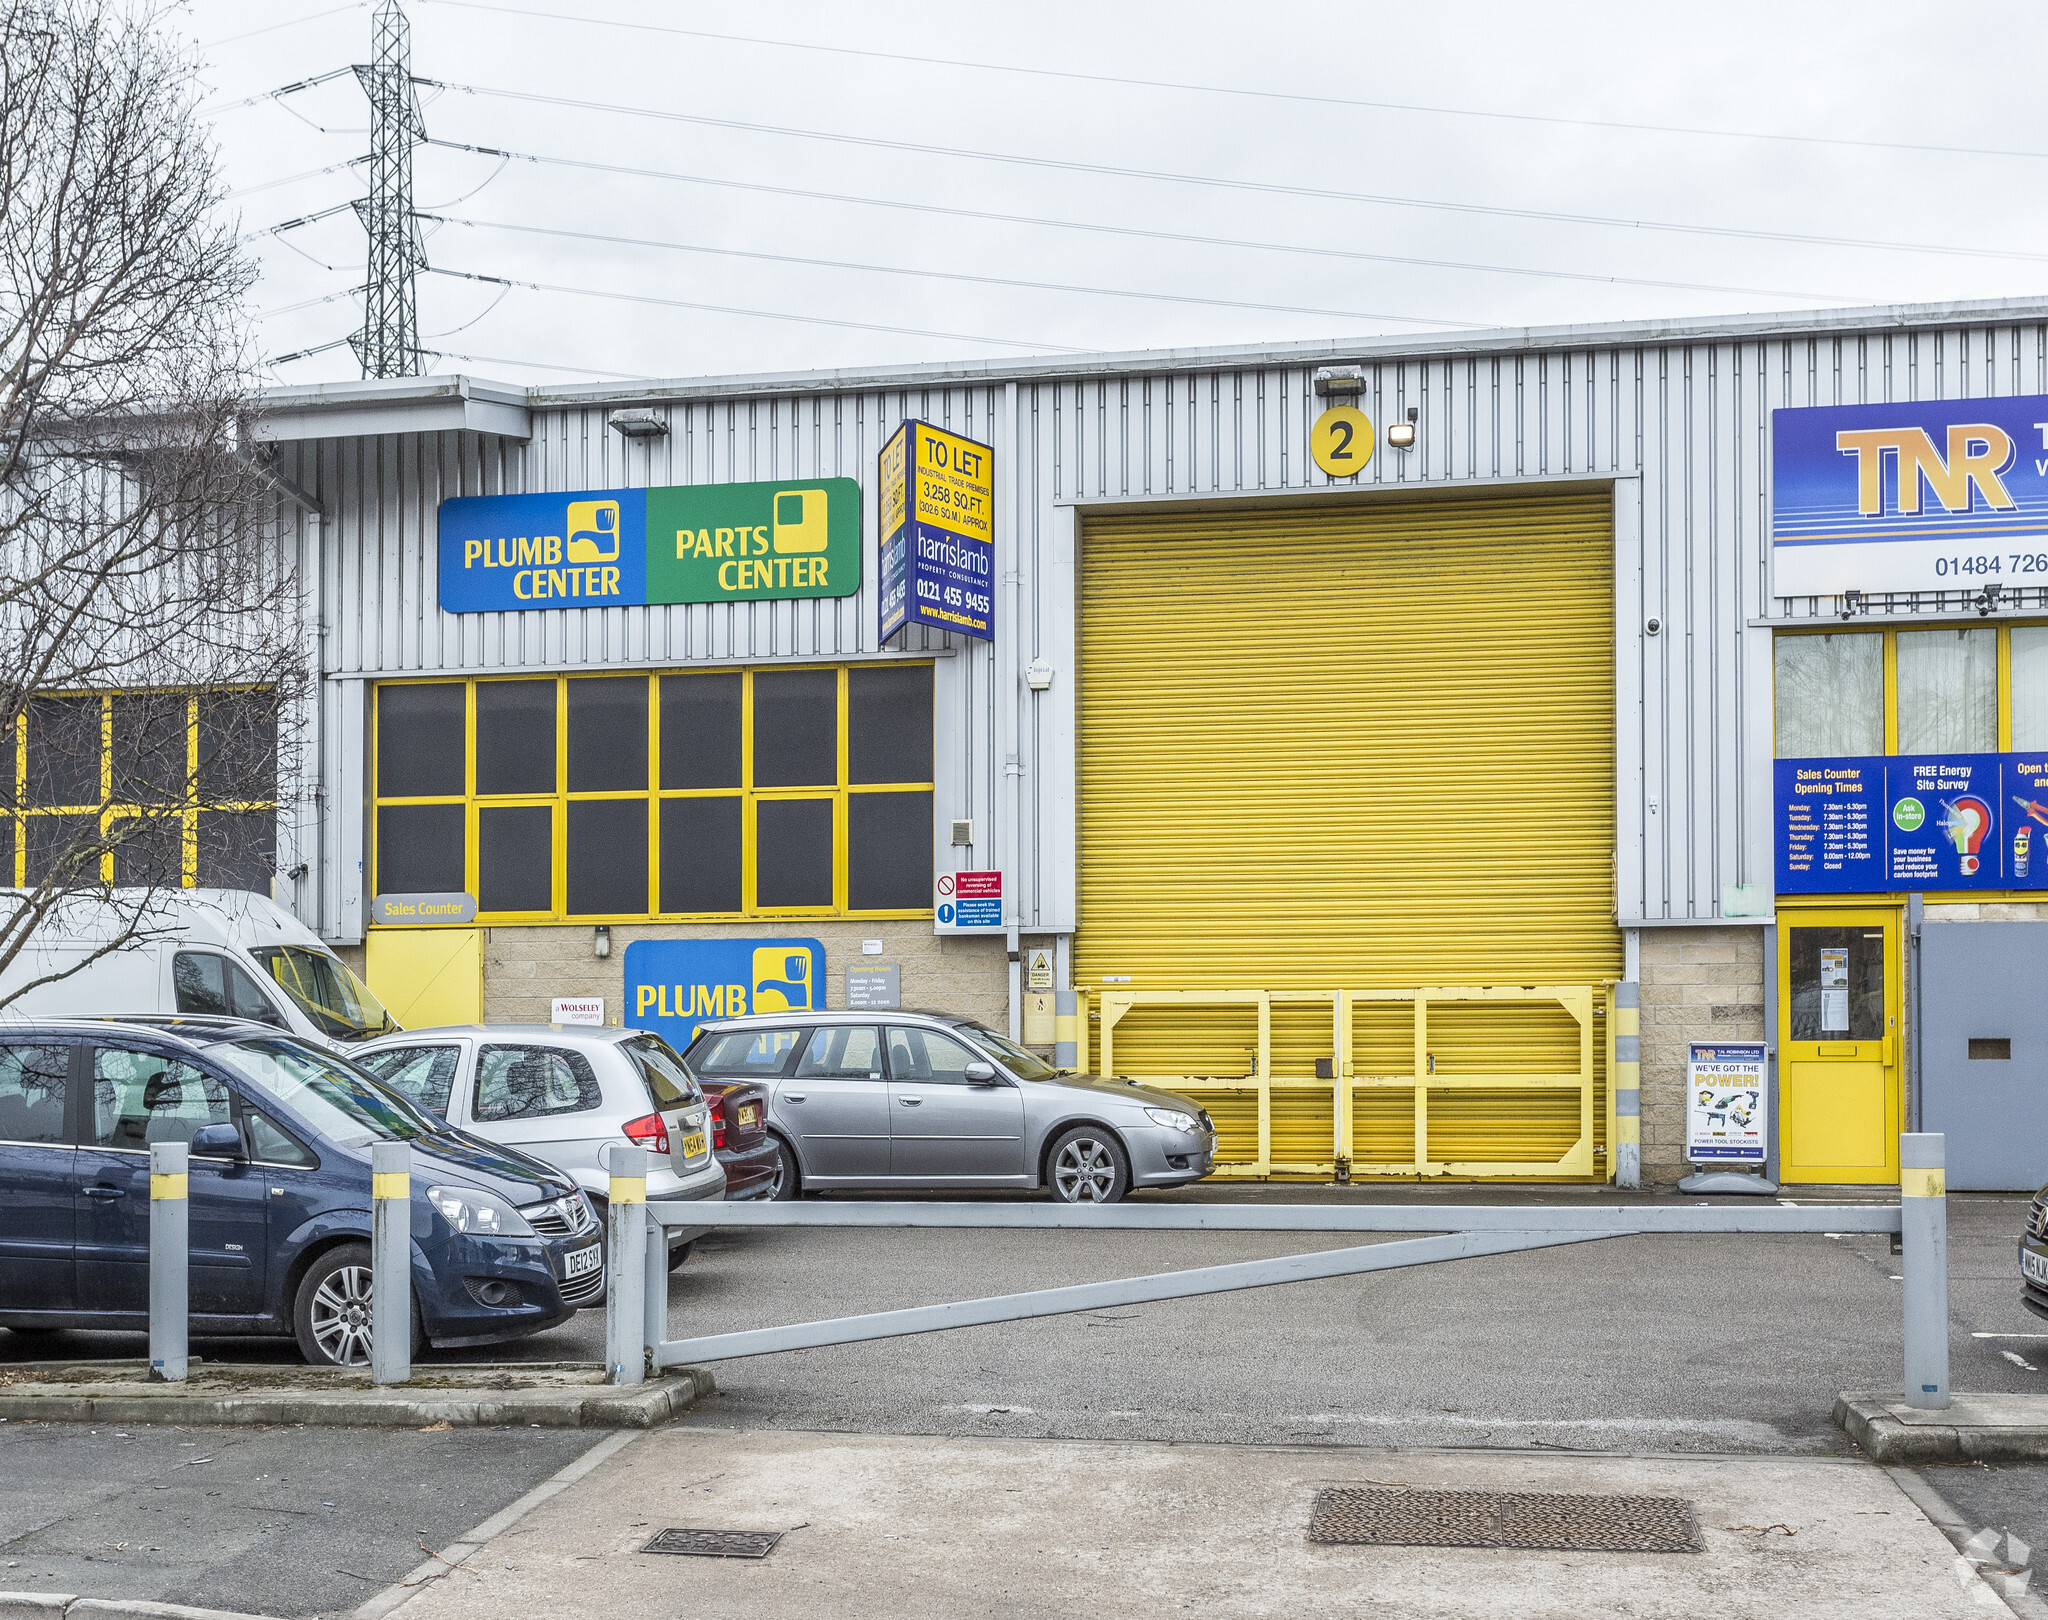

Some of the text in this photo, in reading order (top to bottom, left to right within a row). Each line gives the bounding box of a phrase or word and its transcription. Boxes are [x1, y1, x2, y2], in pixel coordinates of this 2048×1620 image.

[1330, 421, 1353, 459] 2
[926, 437, 982, 478] TO LET
[918, 465, 989, 496] INDUSTRIAL TRADE PREMISES
[1836, 423, 2019, 518] TNR
[924, 482, 950, 504] 3,258
[963, 514, 988, 531] APPROX
[465, 537, 562, 568] PLUMB
[676, 526, 768, 558] PARTS
[719, 557, 828, 590] CENTER
[918, 562, 988, 587] PROPERTY CONSULTANCY
[1935, 556, 2001, 576] 01484
[513, 566, 619, 599] CENTER
[917, 579, 989, 613] 0121 455 9455
[920, 604, 987, 631] www.harrislamb.com
[1797, 769, 1860, 780] Sales Counter
[1914, 765, 1971, 778] FREE Energy
[2018, 763, 2041, 775] Open
[1795, 782, 1862, 795] Opening Times
[1917, 780, 1969, 791] Site Survey
[1847, 813, 1867, 821] 5.30pm
[1903, 804, 1915, 812] Ask
[1847, 823, 1867, 831] 5.30pm
[385, 902, 463, 915] Sales Counter
[637, 985, 746, 1017] PLUMB
[1695, 1049, 1715, 1060] TNR
[1695, 1074, 1759, 1087] POWER!
